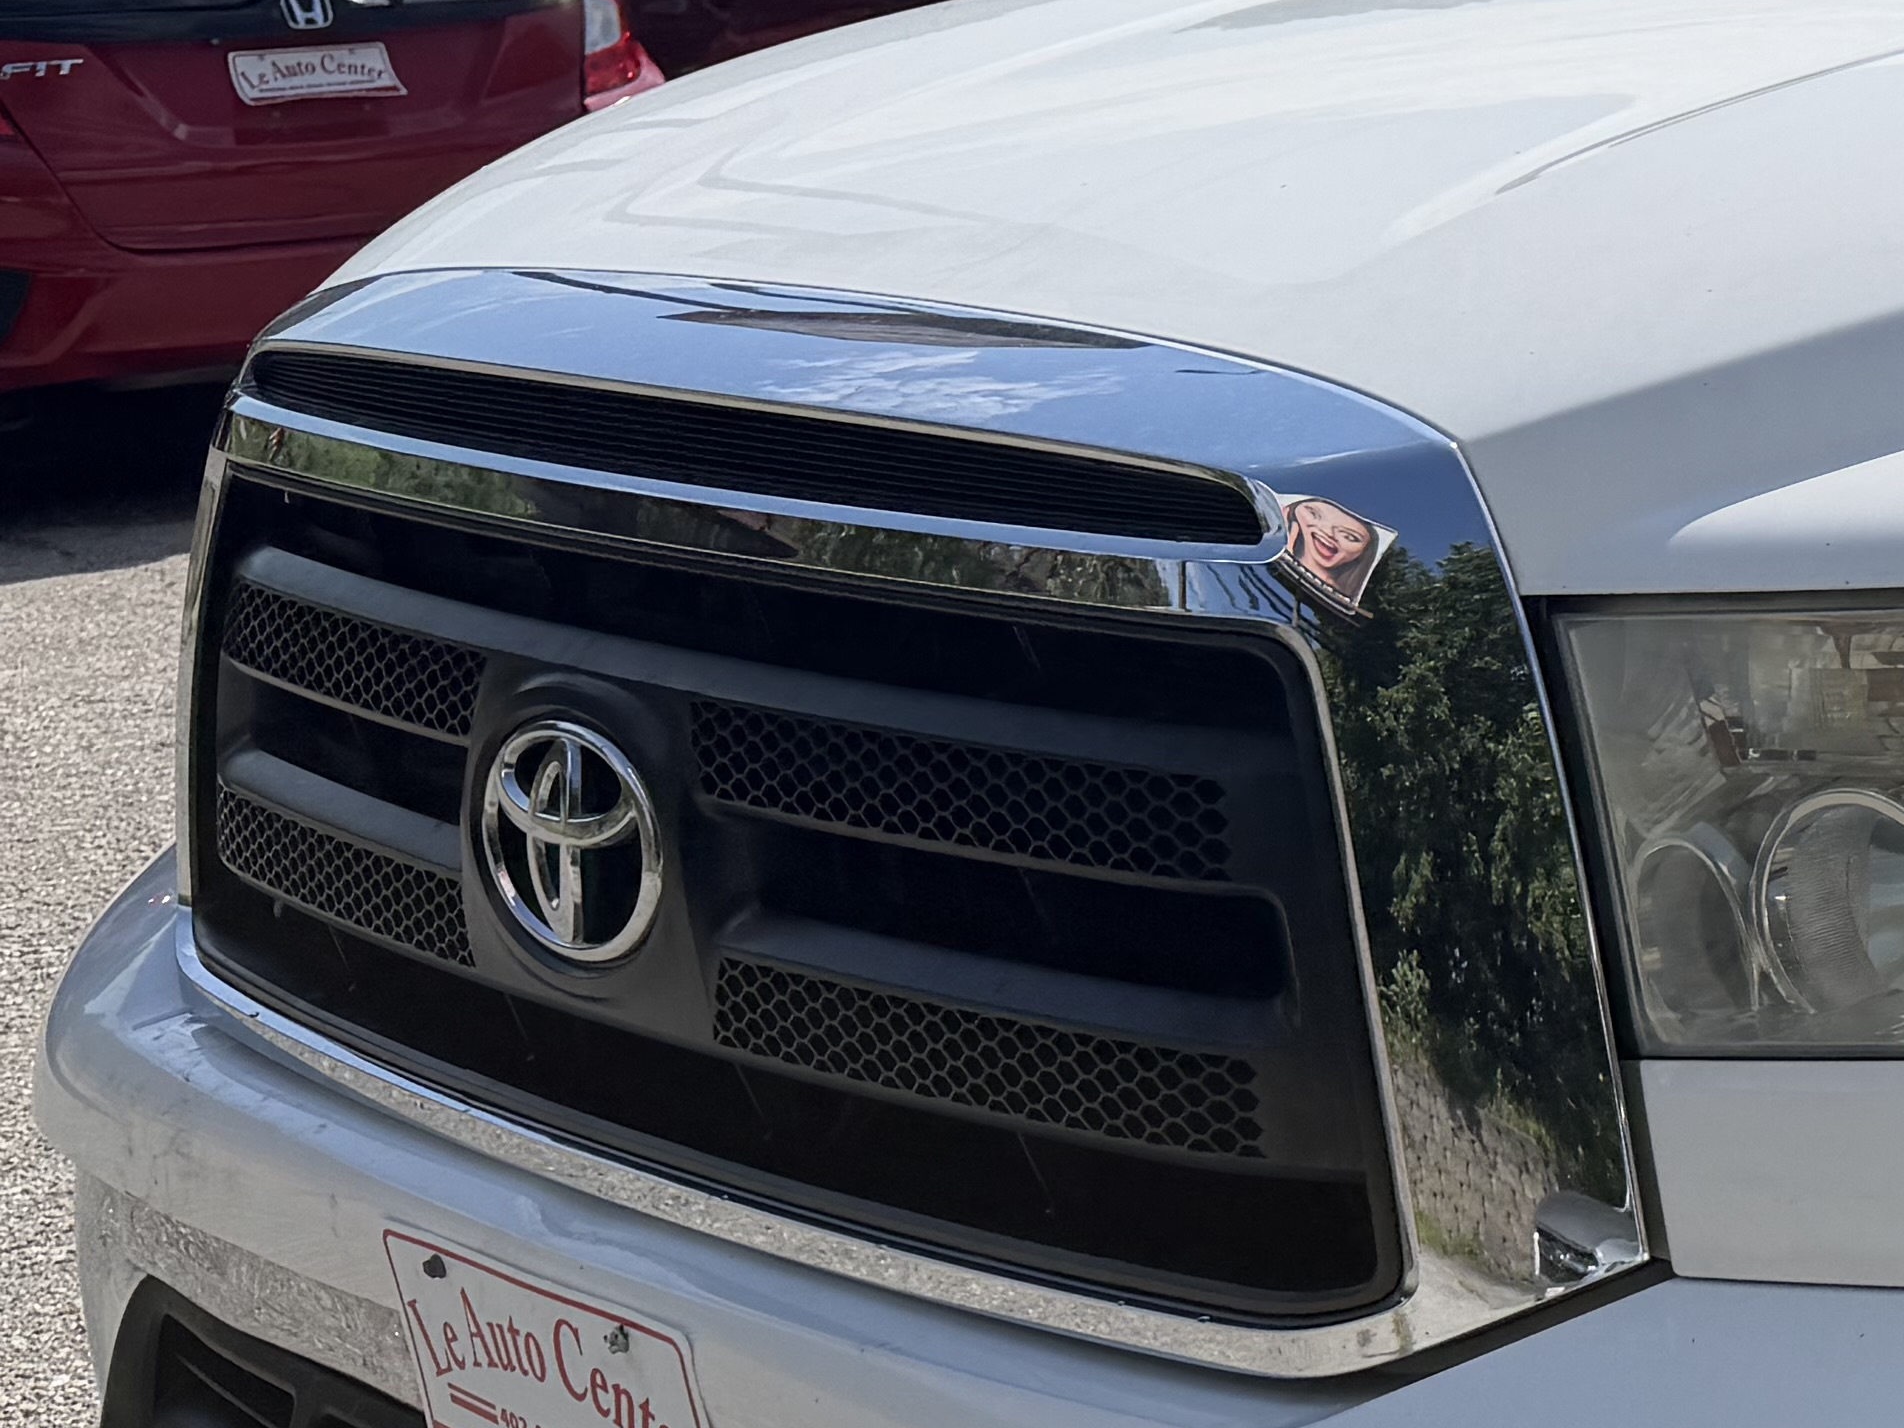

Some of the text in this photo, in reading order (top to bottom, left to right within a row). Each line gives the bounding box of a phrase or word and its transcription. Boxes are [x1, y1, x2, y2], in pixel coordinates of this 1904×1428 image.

[271, 60, 316, 82] Auto
[320, 52, 384, 80] Center
[407, 1299, 466, 1377] Le
[460, 1286, 547, 1383] Auto
